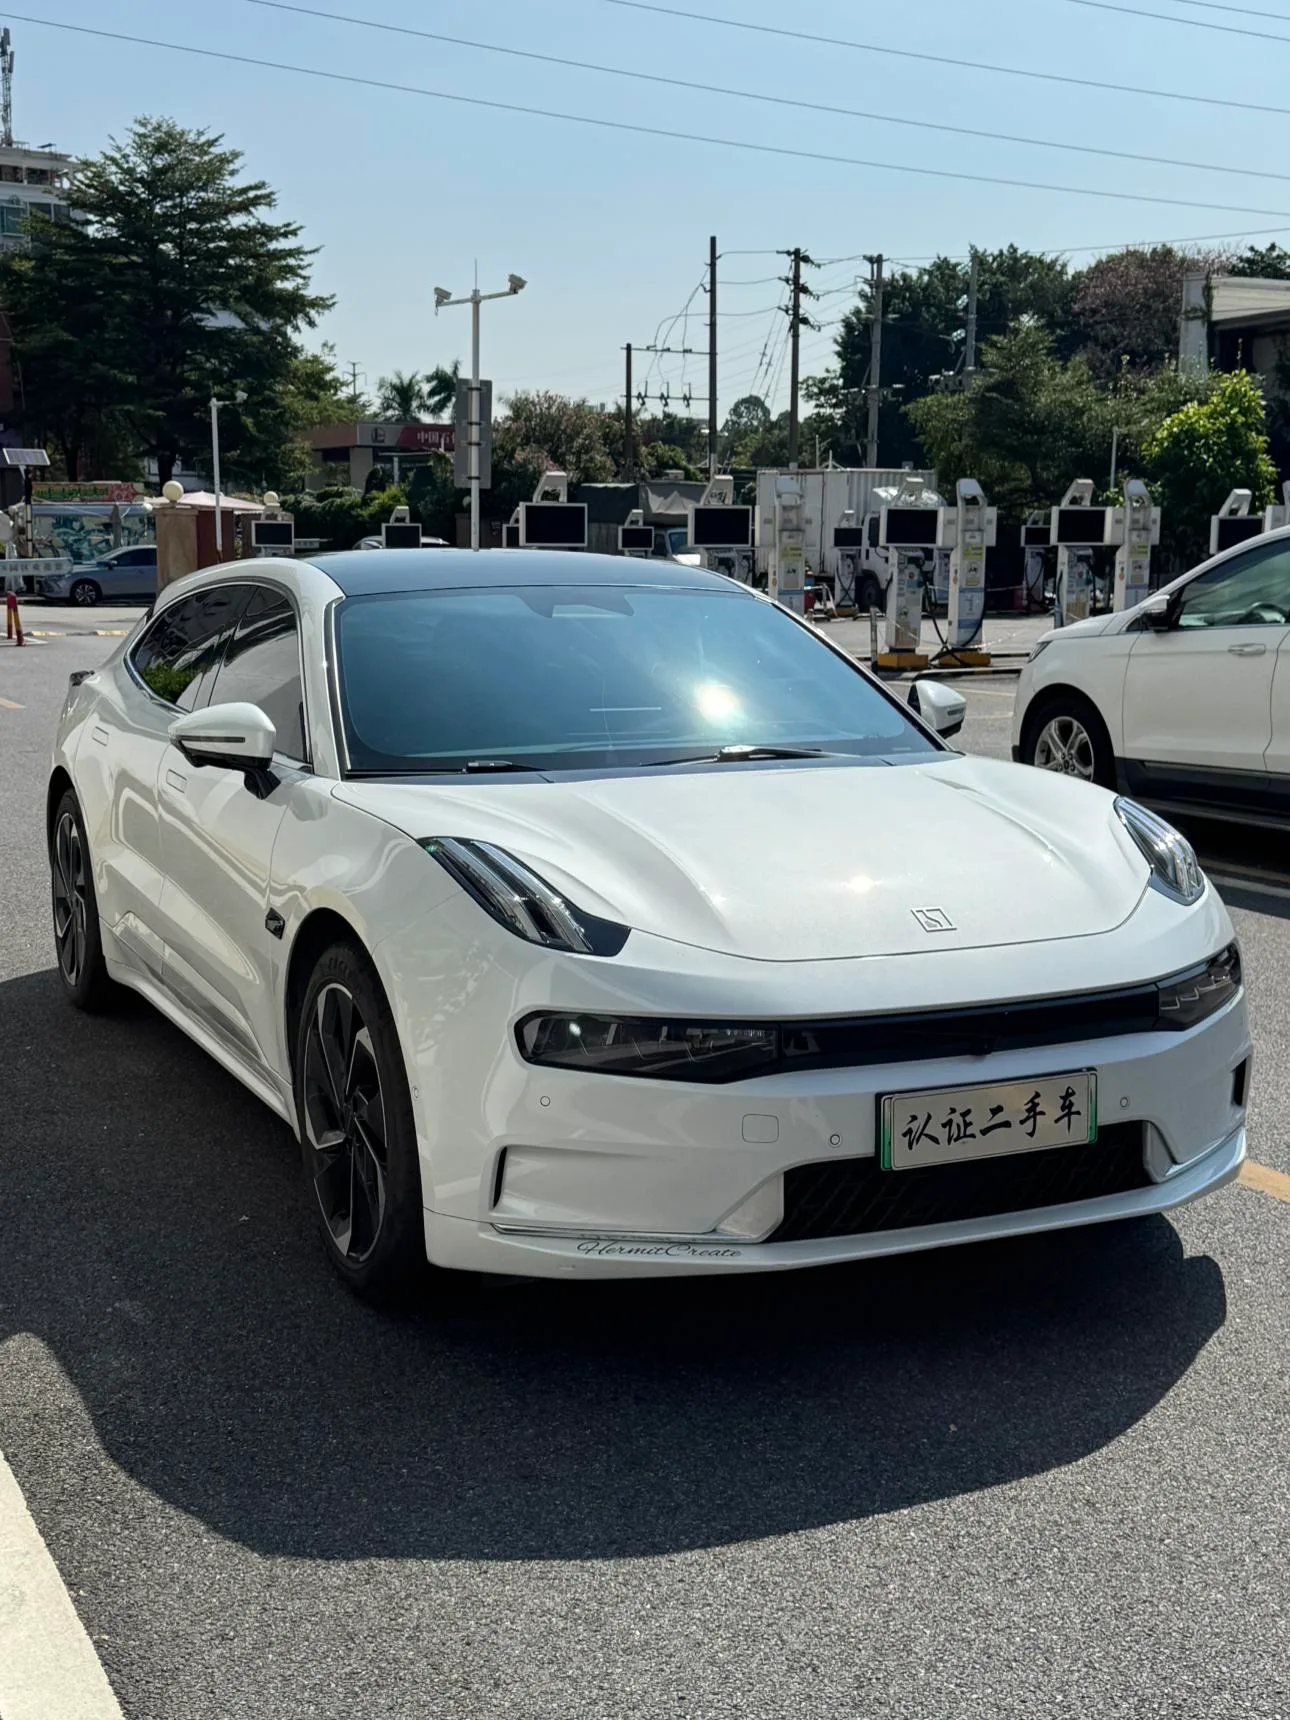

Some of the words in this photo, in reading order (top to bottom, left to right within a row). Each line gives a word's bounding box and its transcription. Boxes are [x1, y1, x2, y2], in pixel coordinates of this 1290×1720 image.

[901, 1086, 1082, 1150] 认证二手车
[576, 1239, 742, 1257] HermitCreate
